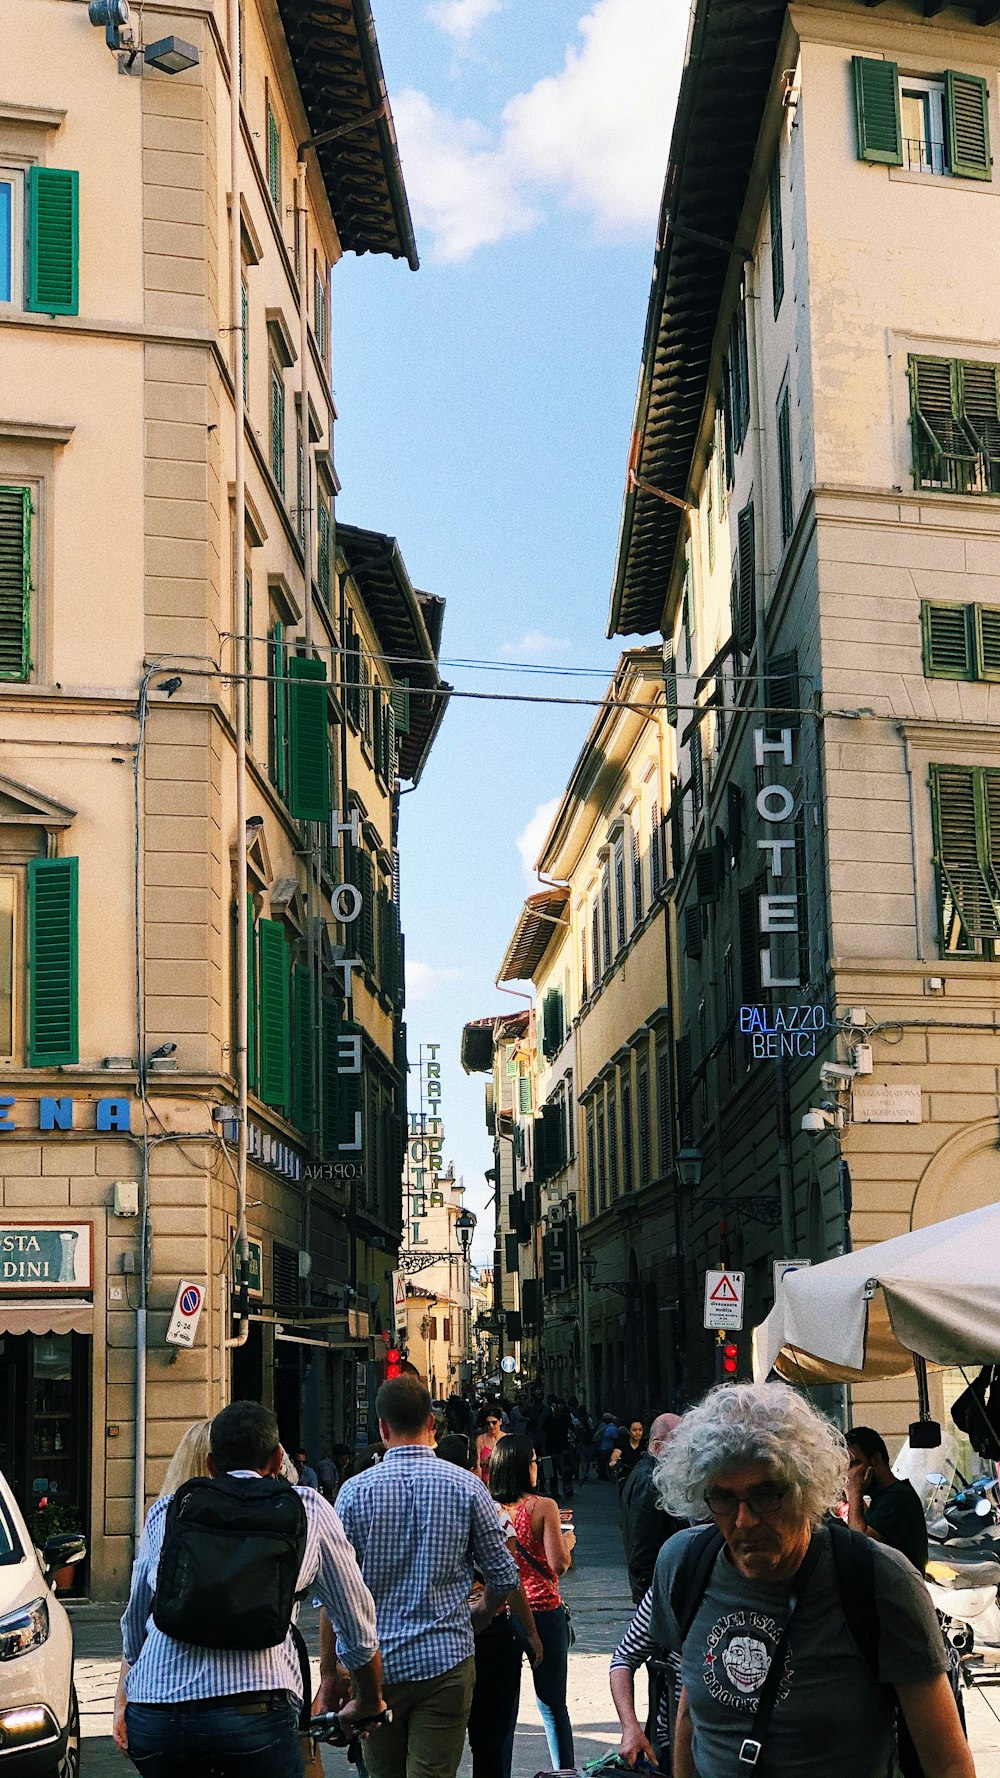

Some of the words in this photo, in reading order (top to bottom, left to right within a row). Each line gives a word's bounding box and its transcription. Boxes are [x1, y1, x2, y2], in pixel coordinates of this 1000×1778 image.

[754, 727, 801, 988] HOTEL
[739, 1004, 826, 1033] PALAZZO
[752, 1033, 817, 1059] BENCI
[427, 1044, 444, 1208] TRATTORIA
[410, 1112, 429, 1245] HOTEL
[0, 1235, 41, 1252] STA
[3, 1261, 50, 1278] DINI
[176, 1321, 192, 1331] 0-24
